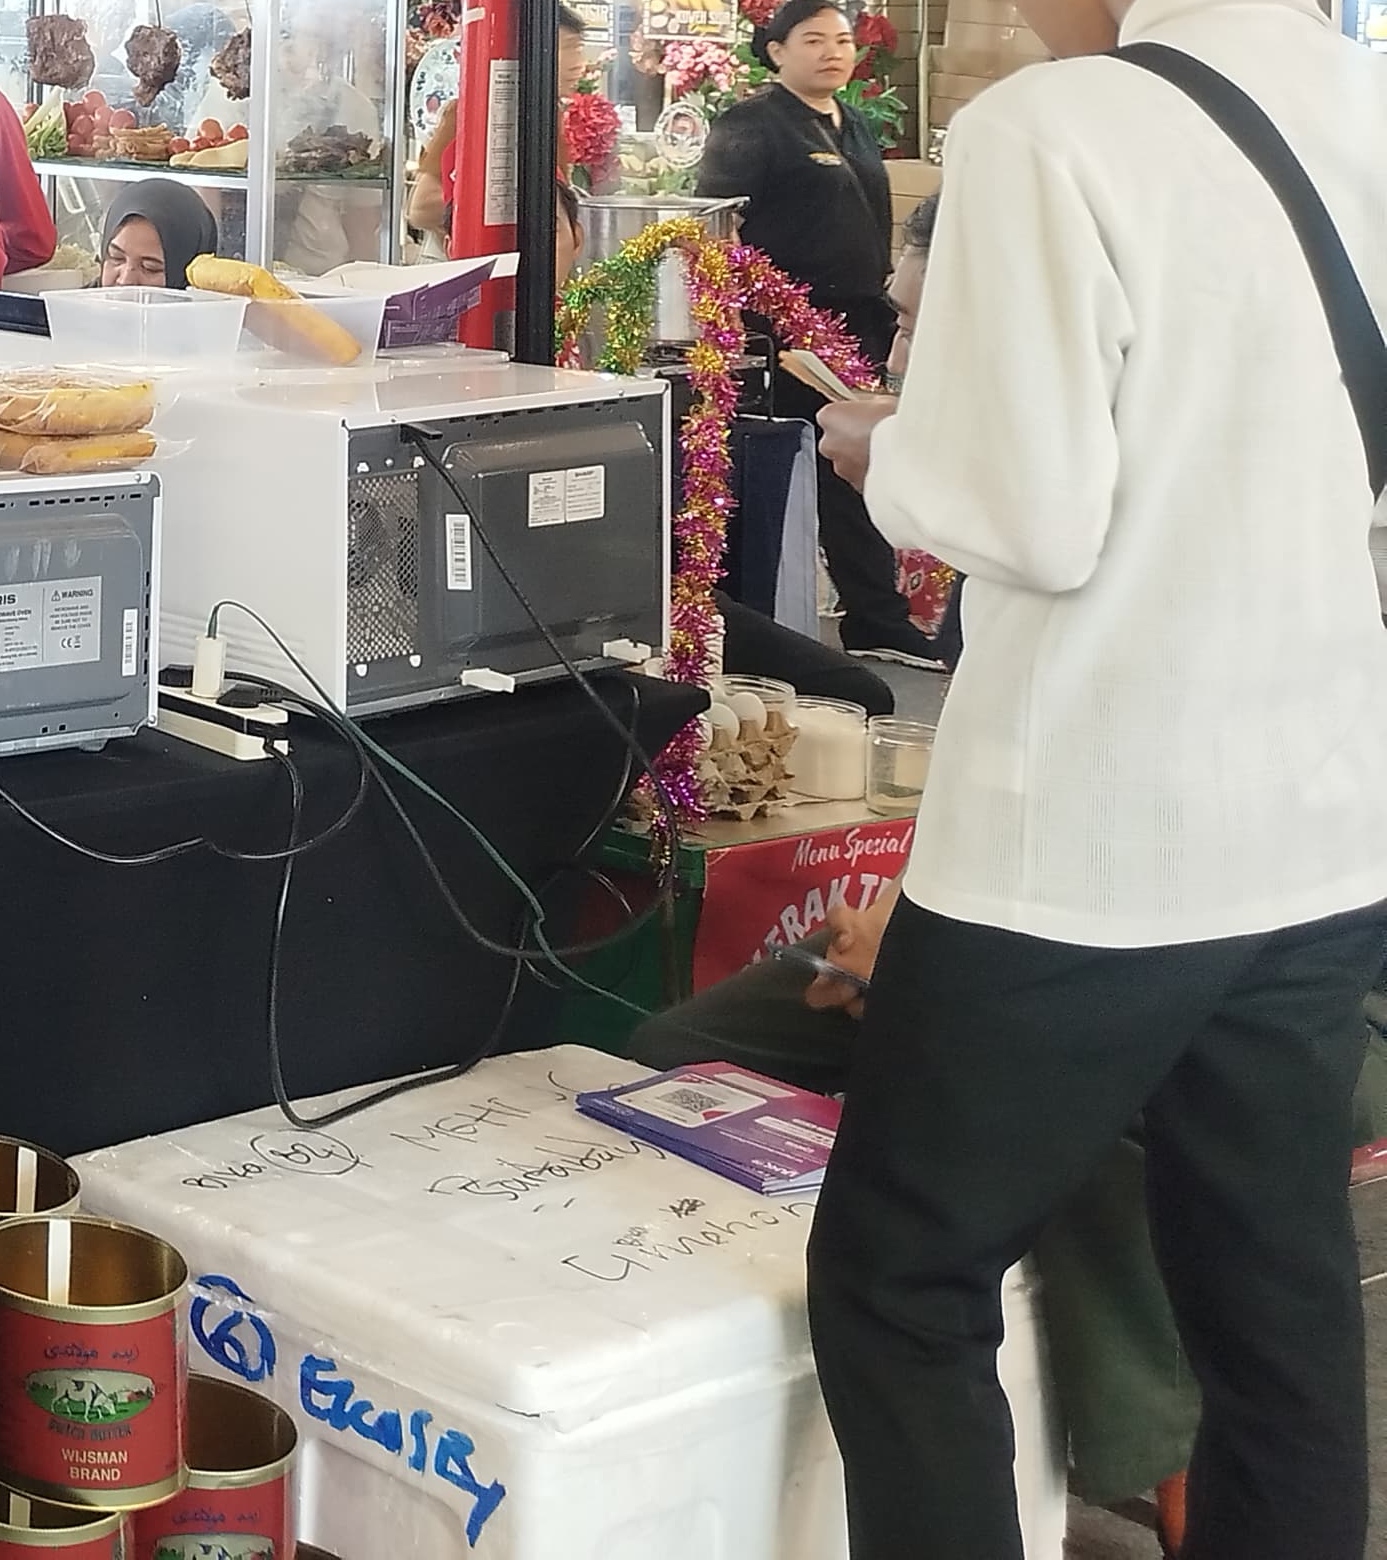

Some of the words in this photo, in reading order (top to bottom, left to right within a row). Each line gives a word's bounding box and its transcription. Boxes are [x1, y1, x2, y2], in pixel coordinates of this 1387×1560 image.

[61, 588, 94, 600] WARNING
[791, 837, 840, 872] Menu
[844, 826, 912, 868] Spesial
[61, 1447, 128, 1464] WIJSMAN
[69, 1466, 121, 1481] BRAND
